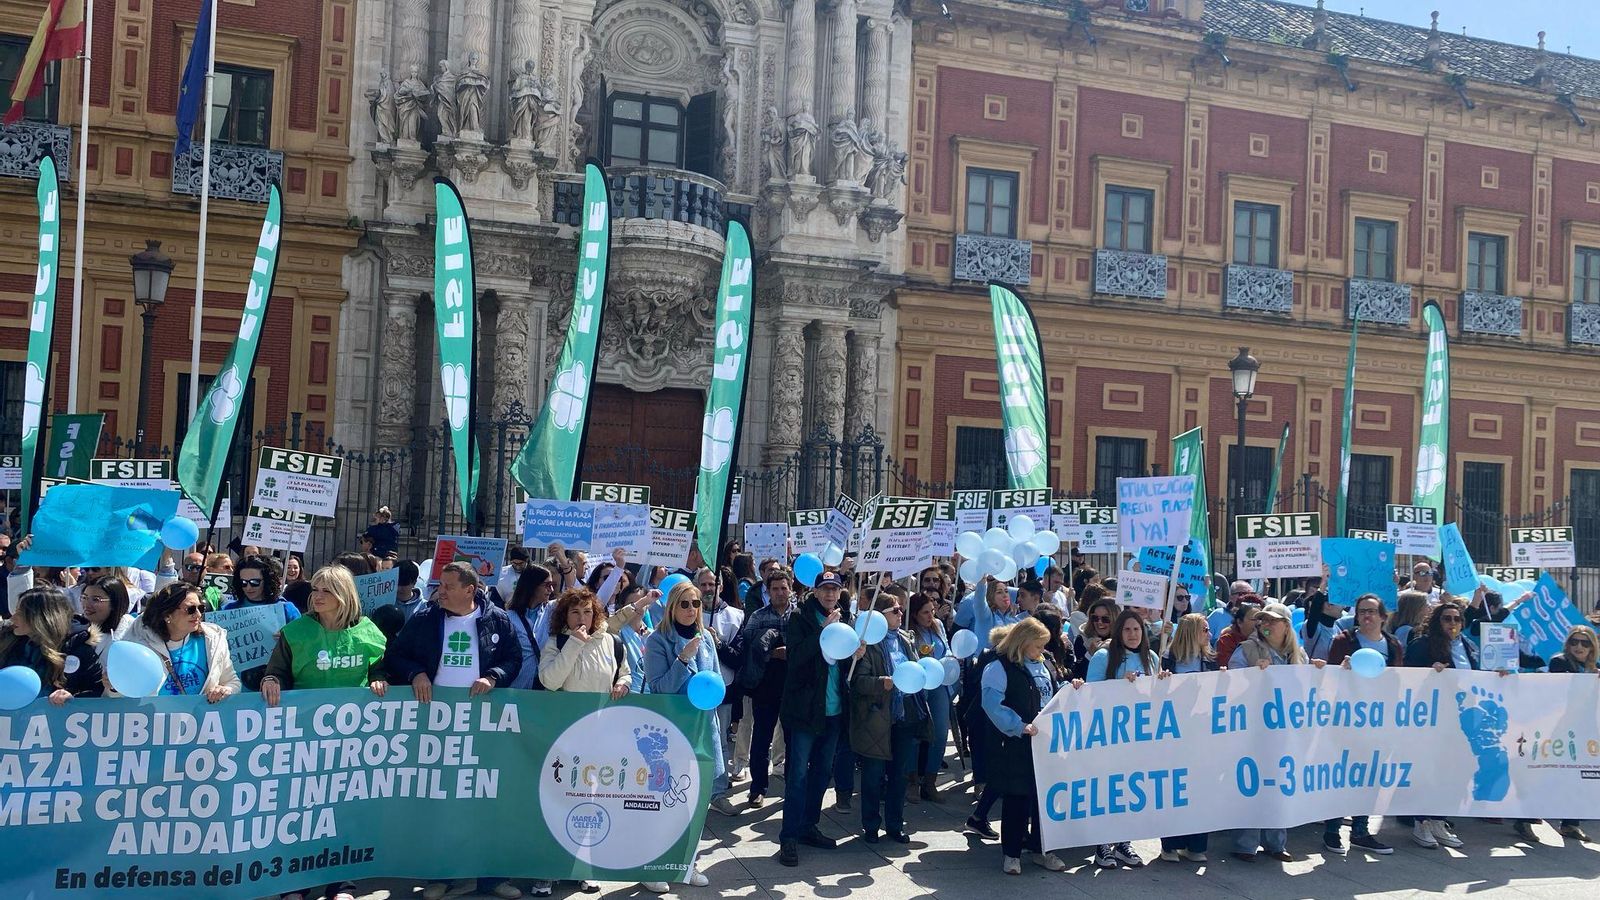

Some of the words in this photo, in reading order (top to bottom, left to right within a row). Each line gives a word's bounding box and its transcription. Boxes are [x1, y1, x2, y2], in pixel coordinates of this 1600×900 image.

[101, 461, 163, 479] FSIE
[270, 450, 334, 478] FSIE
[258, 488, 280, 498] FSIE
[590, 485, 643, 504] FSIE
[957, 492, 987, 509] FSIE
[1000, 490, 1046, 508] FSIE
[257, 507, 306, 523] FSIE
[536, 509, 557, 517] PRECIO
[838, 496, 859, 520] FSIE
[1393, 507, 1433, 524] FSIE
[879, 506, 929, 529] FSIE
[1247, 515, 1312, 538] FSIE
[246, 531, 262, 539] FSIE
[1518, 528, 1567, 542] FSIE
[863, 551, 880, 560] FSIE
[1242, 560, 1262, 568] FSIE
[1492, 568, 1535, 582] FSIE
[367, 579, 396, 598] FUTURO
[333, 654, 364, 669] FSIE
[443, 655, 472, 666] FSIE
[1211, 695, 1247, 734] En
[1262, 687, 1384, 730] defensa
[1395, 688, 1439, 727] del
[0, 715, 53, 750] LA
[64, 711, 226, 748] SUBIDA
[236, 706, 304, 742] DEL
[312, 701, 419, 736] COSTE
[427, 701, 472, 733] DE
[480, 703, 521, 733] LA
[1049, 700, 1181, 753] MAREA
[95, 750, 150, 786] EN
[163, 747, 239, 782] LOS
[247, 734, 408, 777] CENTROS
[418, 735, 479, 766] DEL
[1236, 755, 1296, 798] 0-3
[1303, 749, 1413, 793] andaluz
[95, 784, 221, 821] CICLO
[231, 779, 279, 816] DE
[288, 767, 447, 809] INFANTIL
[455, 768, 499, 799] EN
[1046, 768, 1189, 821] CELESTE
[624, 802, 659, 810] ANDALUCÍA
[108, 803, 337, 855] ANDALUCÍA
[55, 867, 86, 889] En
[94, 863, 196, 888] defensa
[203, 862, 242, 886] del
[248, 857, 283, 882] 0-3
[287, 845, 375, 873] andaluz
